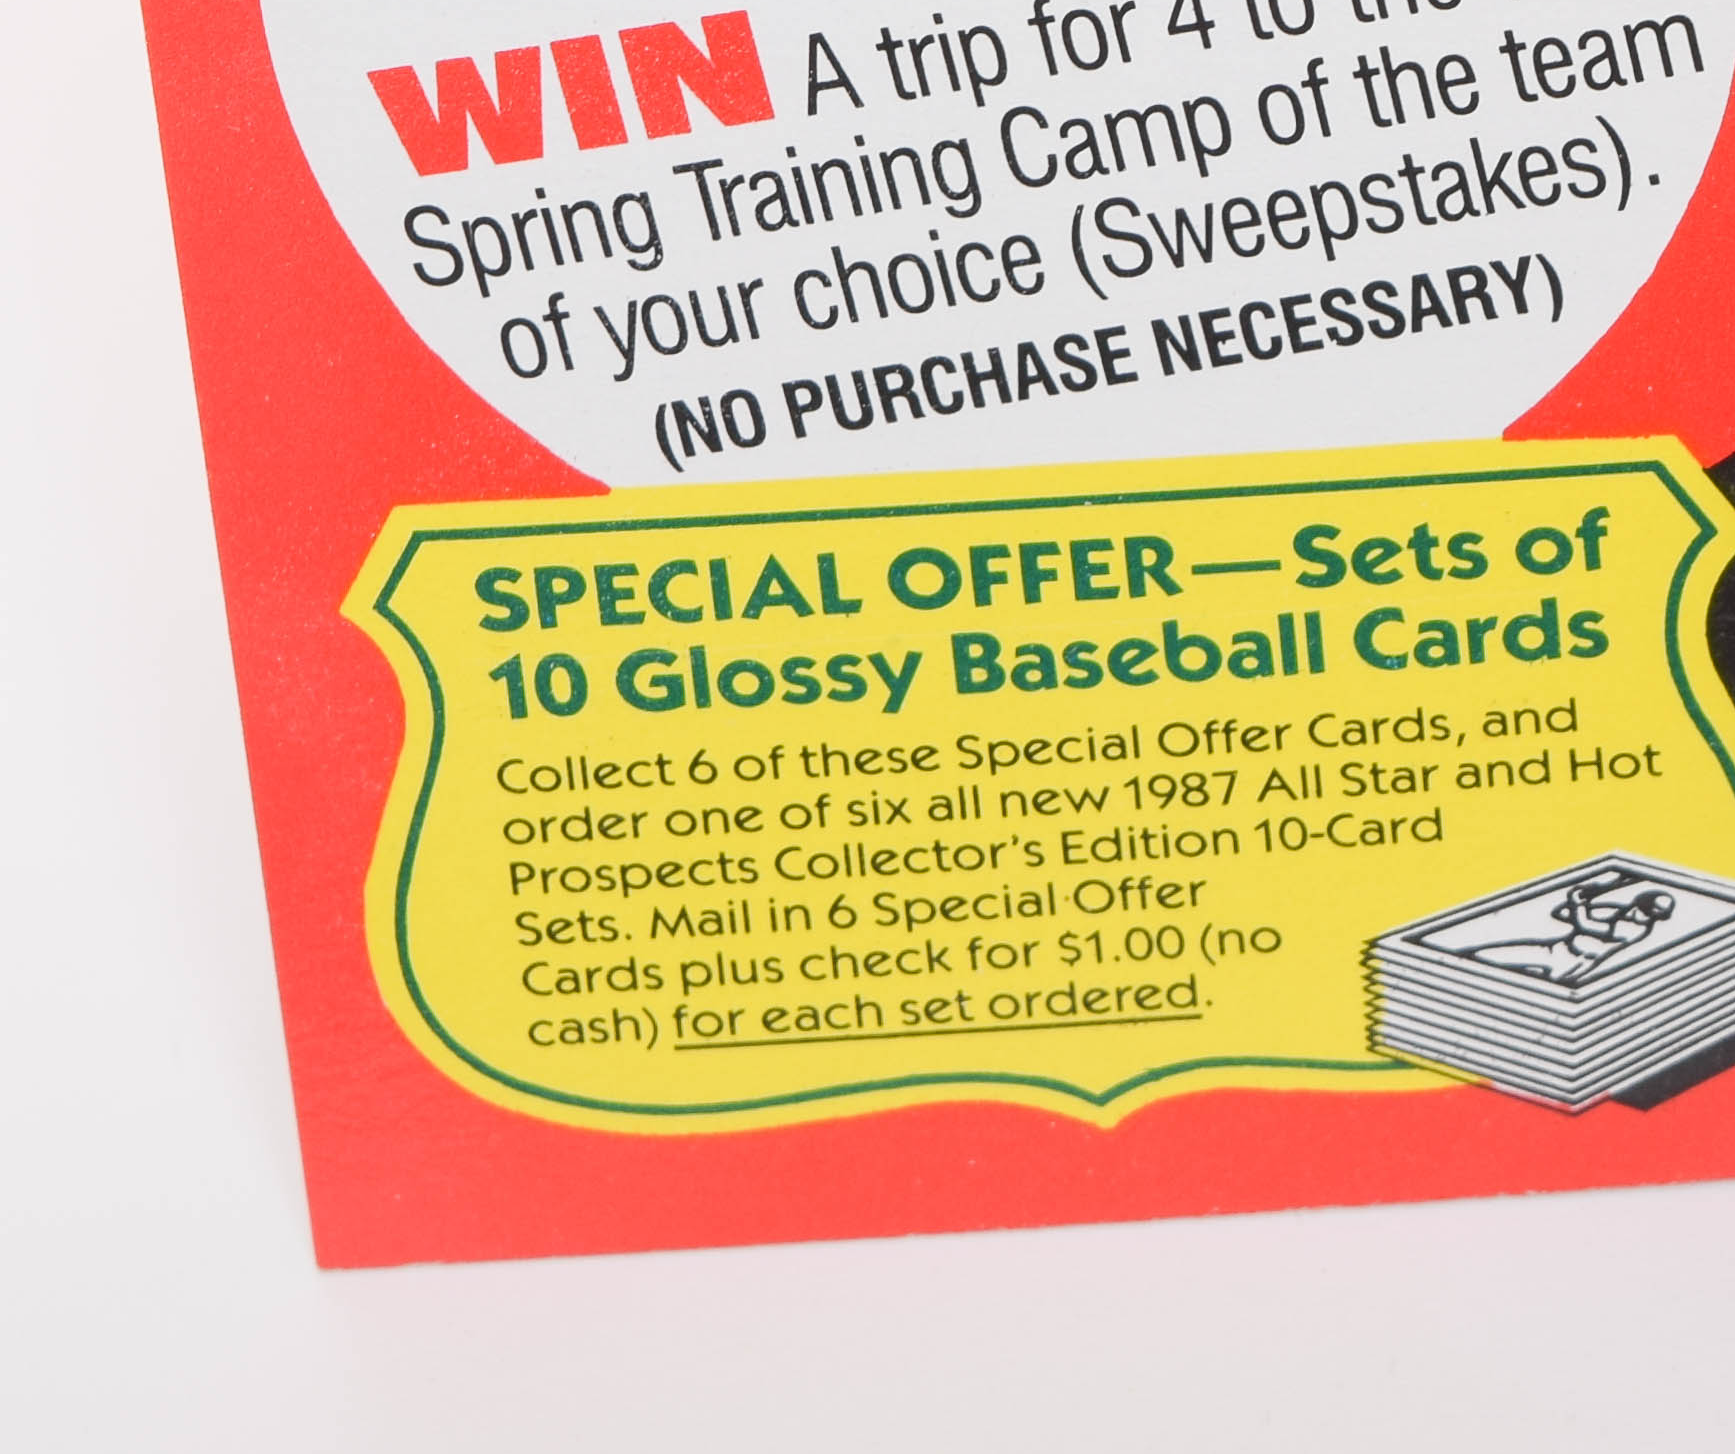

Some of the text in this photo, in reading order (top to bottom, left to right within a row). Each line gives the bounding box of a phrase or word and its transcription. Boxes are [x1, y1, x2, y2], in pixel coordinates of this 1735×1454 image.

[368, 10, 774, 176] WIN
[808, 33, 864, 116] A
[876, 13, 1007, 107] trip
[404, 15, 1704, 298] Spring Training Camp of the team
[501, 116, 1659, 381] of your choice (Sweepstakes).
[656, 254, 1563, 472] (NO PURCHASE NECESSARY)
[475, 553, 862, 631] SPECIAL
[1516, 507, 1609, 574] of
[490, 598, 1608, 718] 10 Glossy Baseball Cards
[497, 698, 1577, 794] Collect 6 of these Special Offer Cards, and
[503, 745, 1662, 845] order one of six all new 1987 All Star and Hot
[510, 807, 1442, 898] Prospects Collector's Edition 10-Card
[515, 876, 1206, 946] Sets. Mail in 6 Special Offer
[522, 923, 1282, 996] Cards plus check for $1.00 (no
[528, 974, 1212, 1050] cash) for each set ordered.
